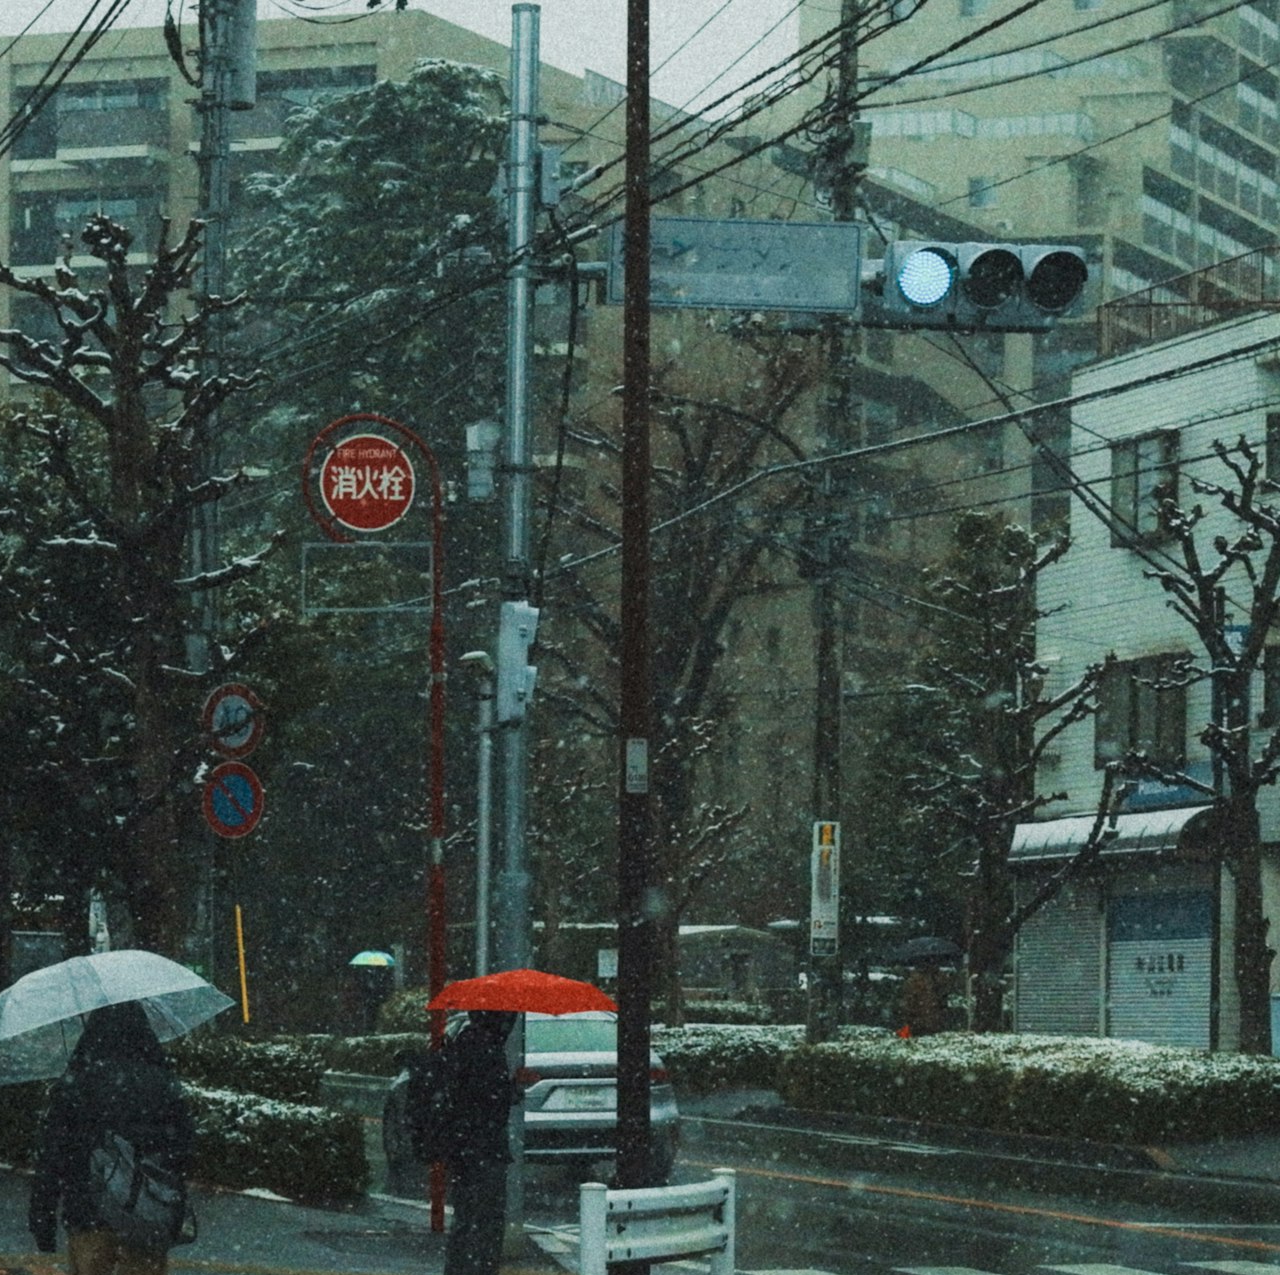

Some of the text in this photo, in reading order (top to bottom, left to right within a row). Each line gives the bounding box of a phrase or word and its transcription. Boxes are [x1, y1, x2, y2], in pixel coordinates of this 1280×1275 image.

[337, 448, 397, 459] FIRE HYDRANT
[331, 465, 406, 500] 消火栓
